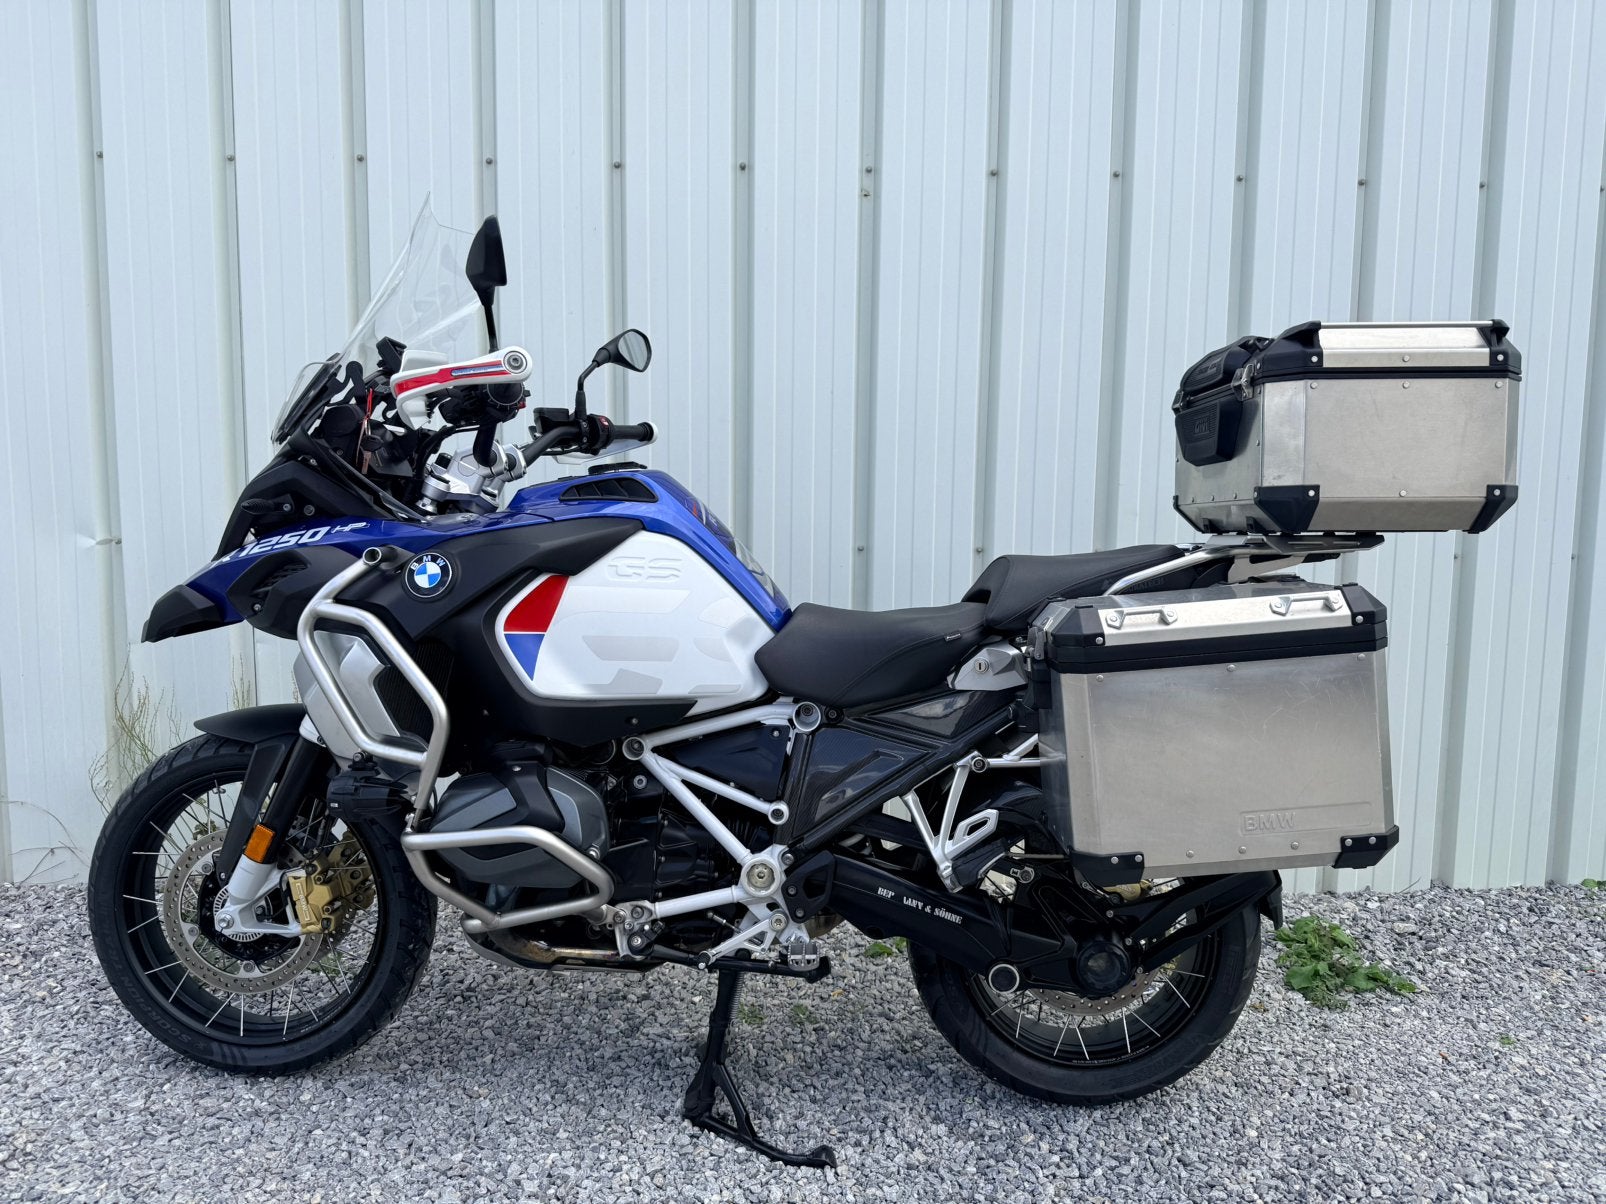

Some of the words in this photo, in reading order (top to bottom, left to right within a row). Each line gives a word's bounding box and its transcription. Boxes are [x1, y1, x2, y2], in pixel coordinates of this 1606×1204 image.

[239, 526, 331, 558] 1250
[410, 554, 446, 571] BMW
[605, 556, 682, 582] GS
[1244, 812, 1296, 831] BMW
